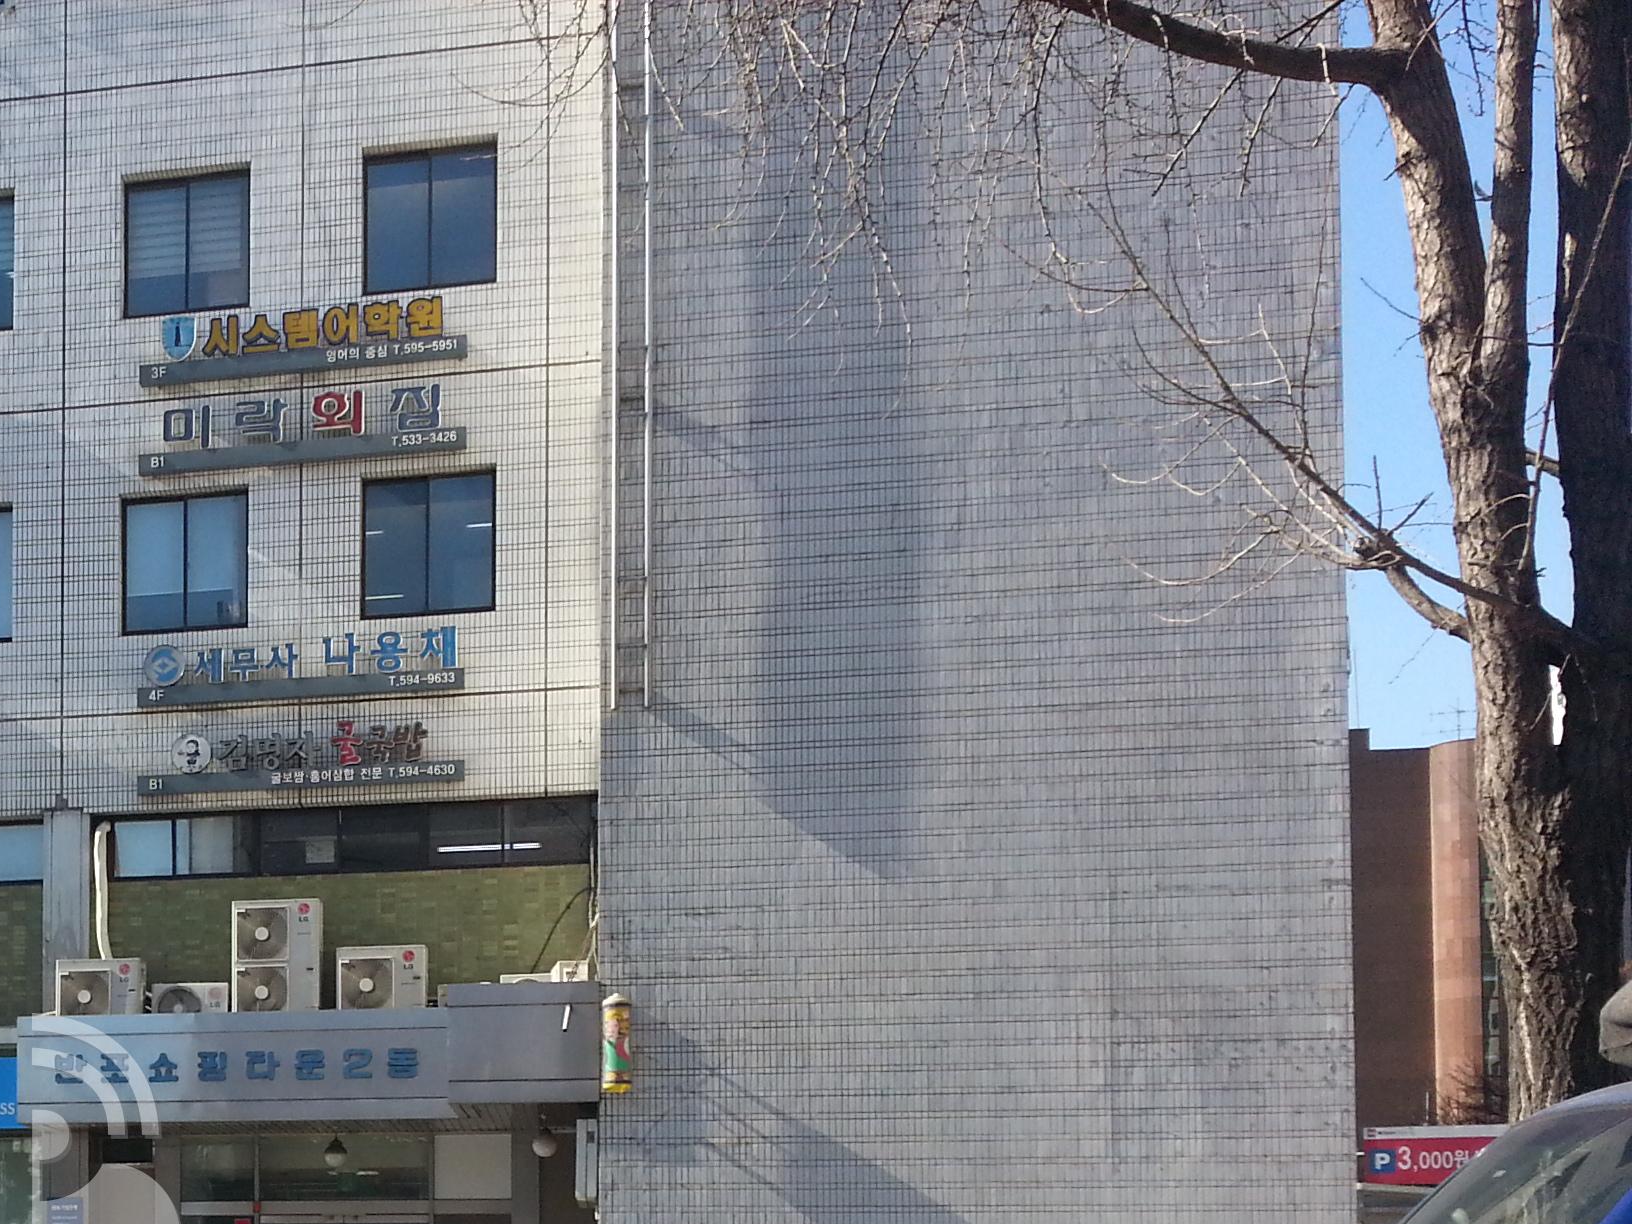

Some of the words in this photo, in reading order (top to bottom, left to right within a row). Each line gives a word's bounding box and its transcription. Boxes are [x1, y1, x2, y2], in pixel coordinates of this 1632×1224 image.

[202, 296, 444, 356] 시스템어학원
[150, 366, 167, 380] 3F
[391, 431, 458, 448] T.533-3426
[150, 456, 165, 468] B1
[194, 642, 299, 684] 세무사
[389, 671, 456, 688] T.594-9633
[148, 690, 165, 702] 4F
[388, 764, 456, 780] T.594-4630
[148, 778, 163, 791] B1
[1374, 1153, 1391, 1170] P
